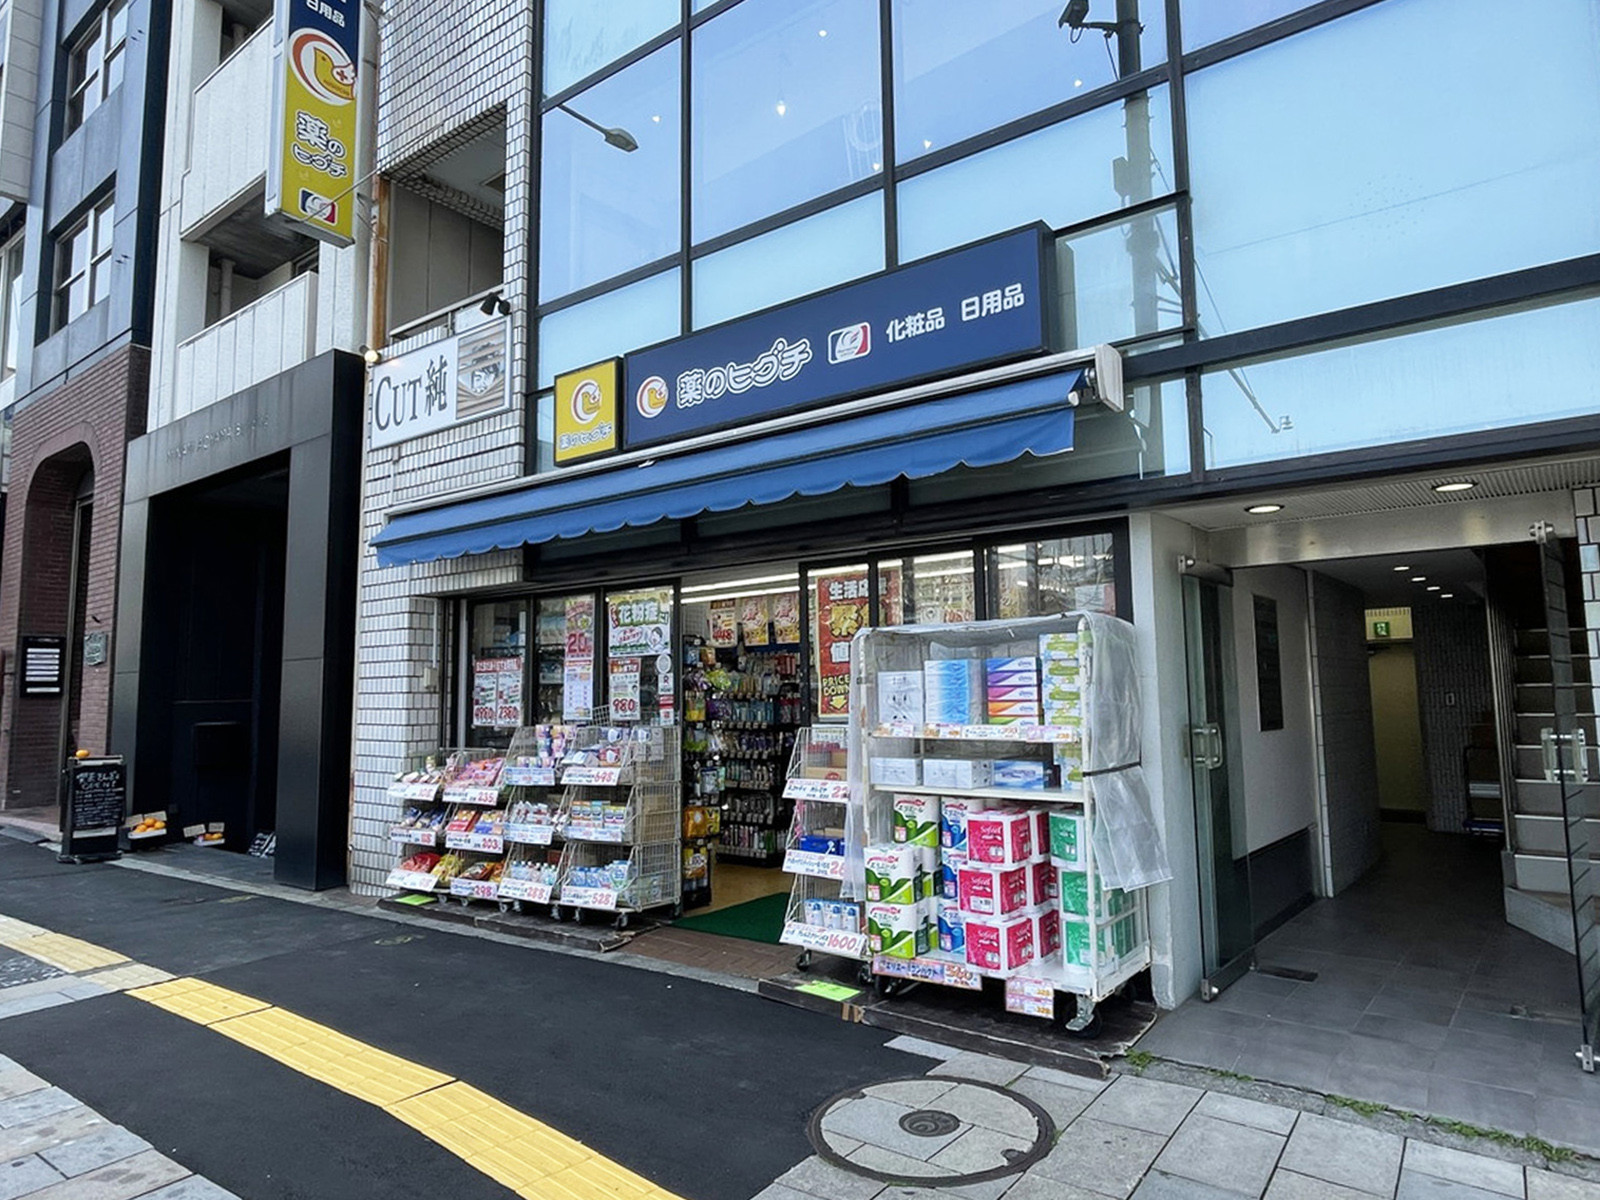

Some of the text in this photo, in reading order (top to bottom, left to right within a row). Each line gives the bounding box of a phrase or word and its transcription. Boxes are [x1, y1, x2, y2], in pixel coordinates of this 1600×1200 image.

[677, 283, 1025, 409] 薬のヒグチ 化粧品 日用品
[823, 674, 850, 688] PRICE
[613, 699, 635, 713] 980
[828, 934, 858, 950] 1600
